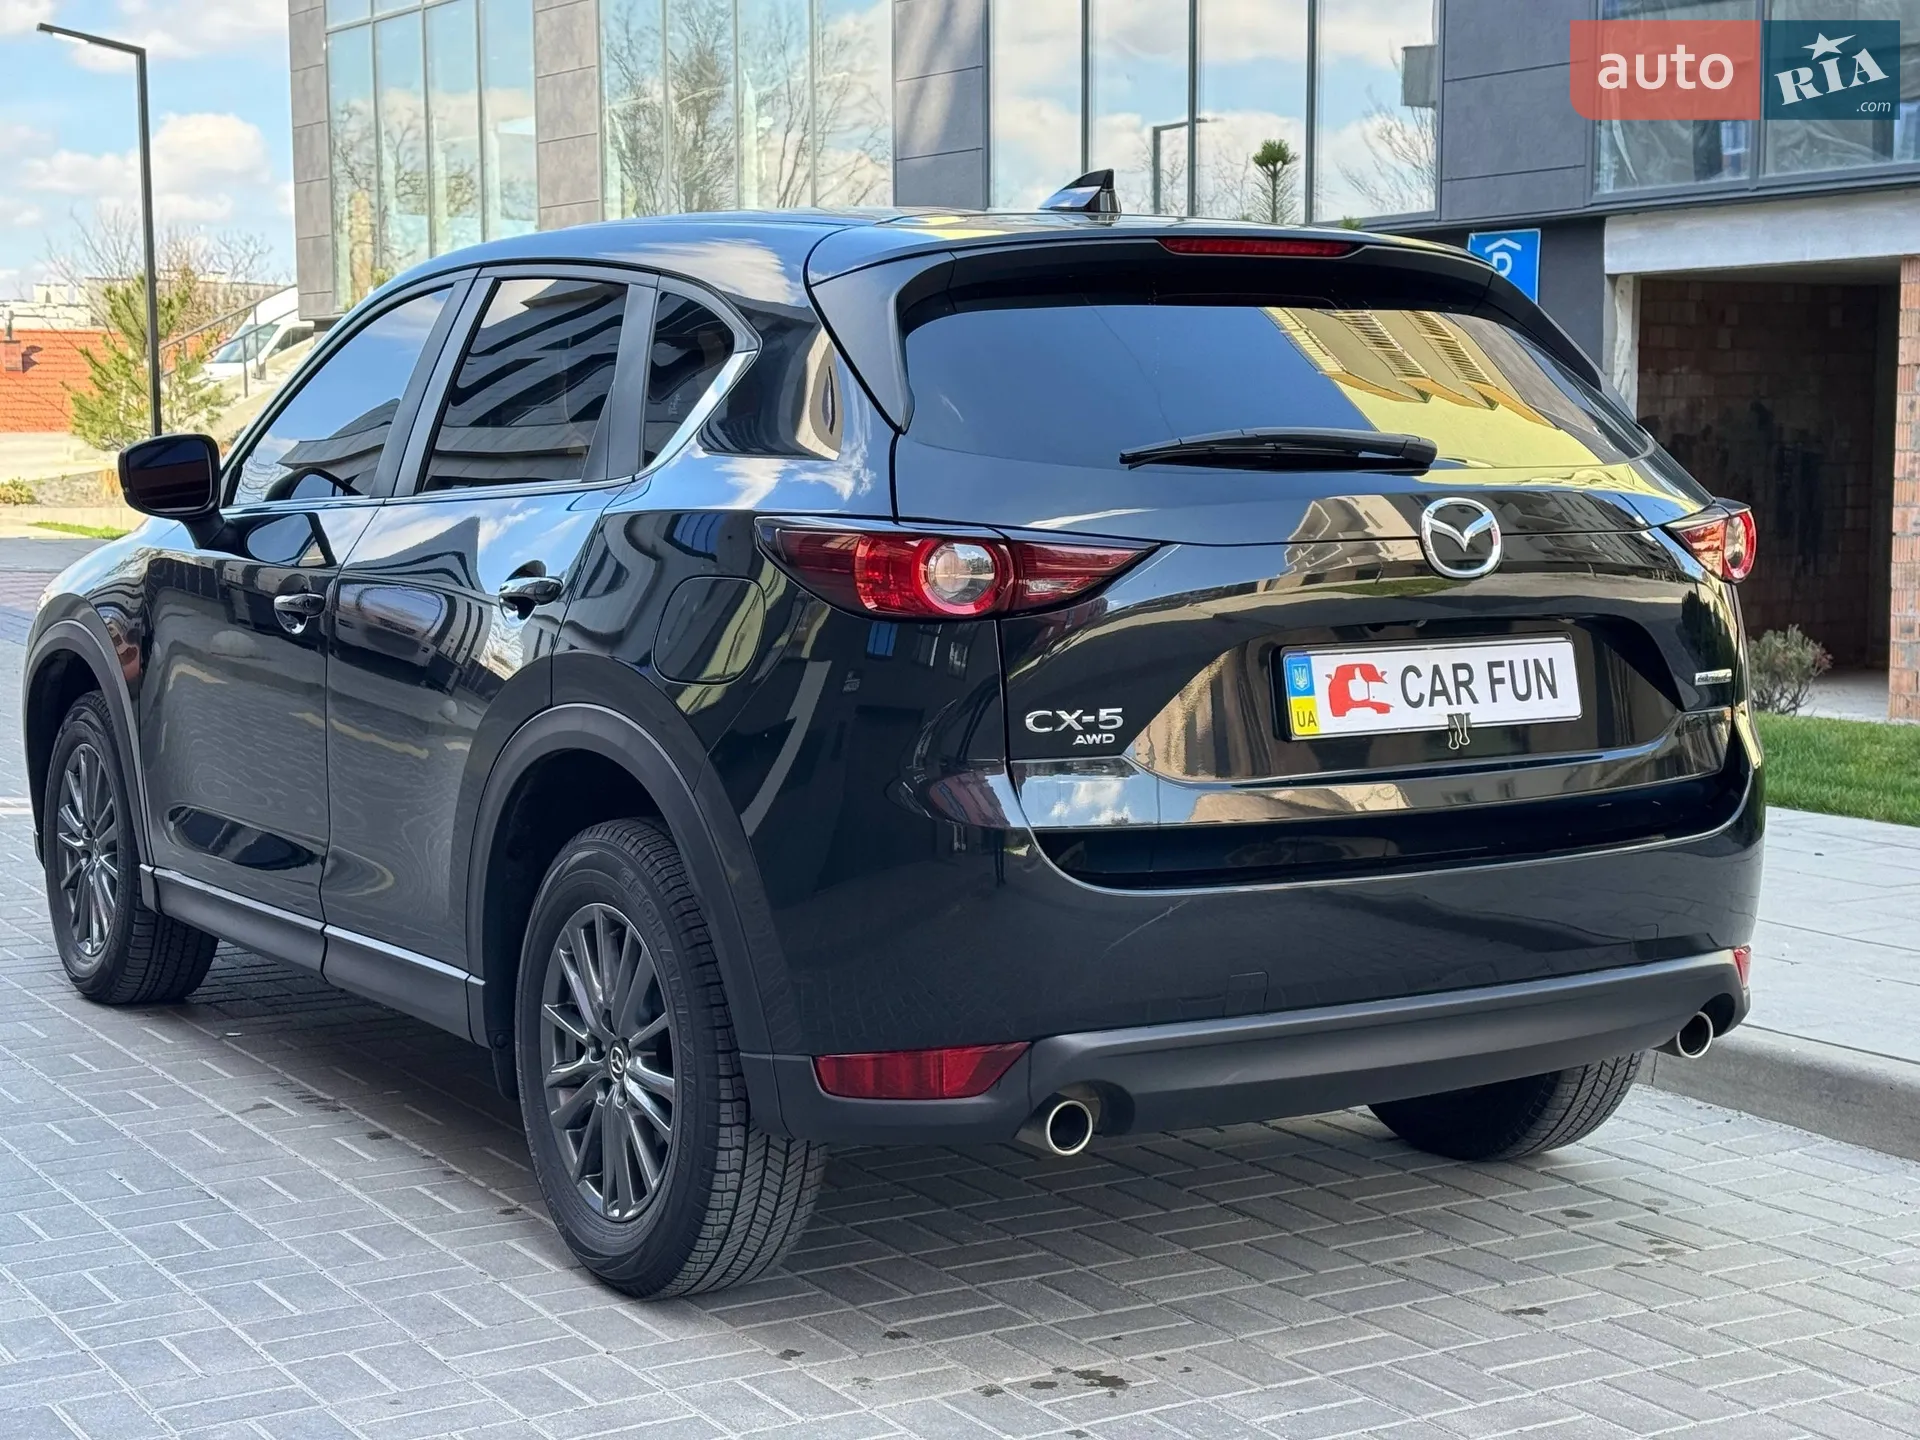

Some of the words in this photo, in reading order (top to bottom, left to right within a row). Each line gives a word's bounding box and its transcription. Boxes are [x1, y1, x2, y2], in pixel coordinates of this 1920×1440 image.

[1400, 662, 1479, 709] CAR
[1487, 657, 1558, 703] FUN
[1025, 707, 1124, 733] CX-5
[1297, 710, 1317, 728] UA
[1072, 733, 1116, 746] AWD
